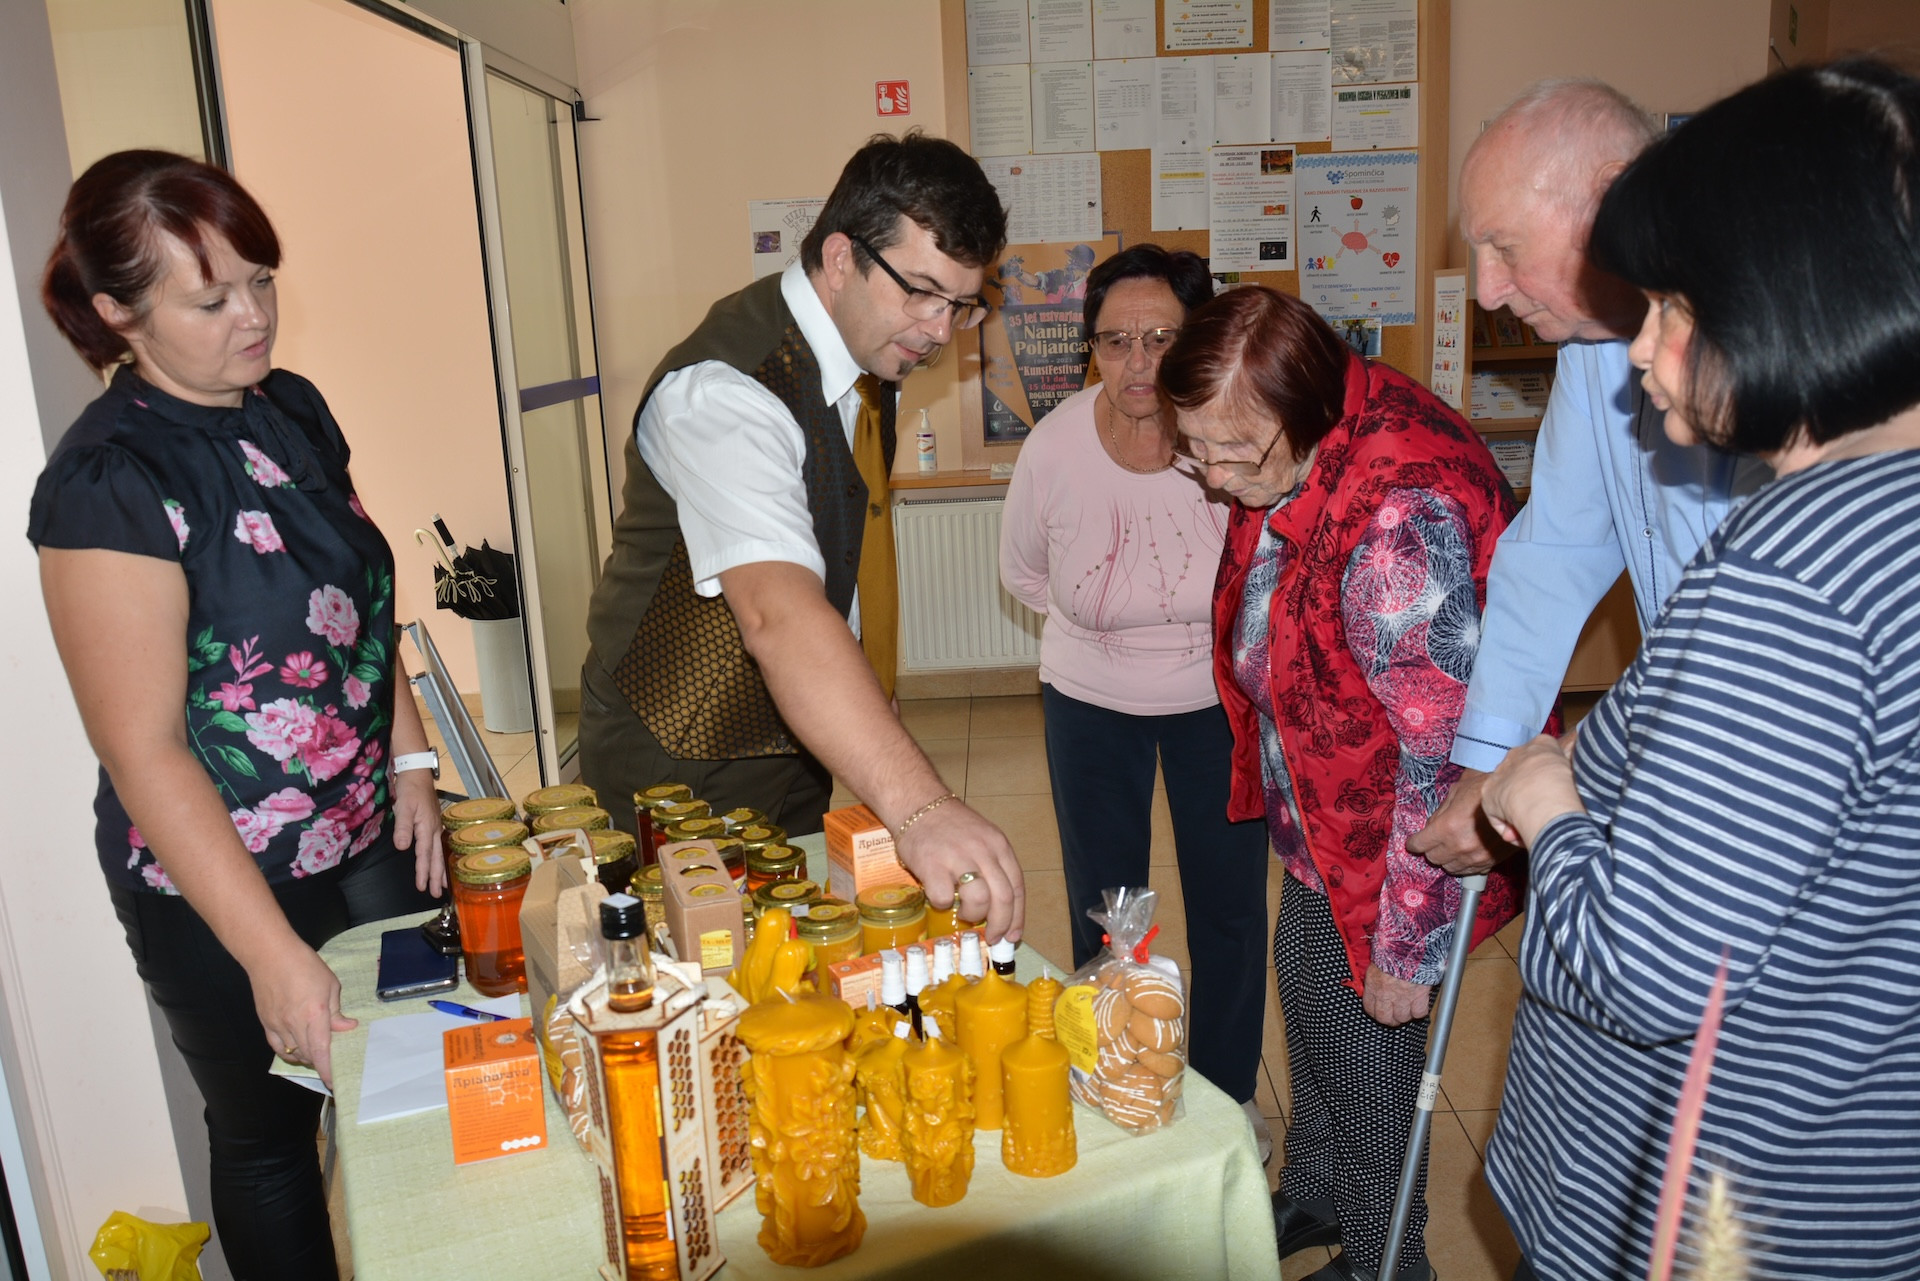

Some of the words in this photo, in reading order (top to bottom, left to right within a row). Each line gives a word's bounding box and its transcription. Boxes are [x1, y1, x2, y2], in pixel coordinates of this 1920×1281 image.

[1344, 169, 1385, 178] Spominčica
[1009, 314, 1022, 327] 35
[1024, 312, 1037, 324] let
[1040, 310, 1084, 324] ustvarjan
[1024, 324, 1078, 341] Nanija
[1015, 340, 1089, 357] Poljanca
[1041, 382, 1079, 391] dogodkov
[1029, 391, 1055, 399] ROGAŠKA
